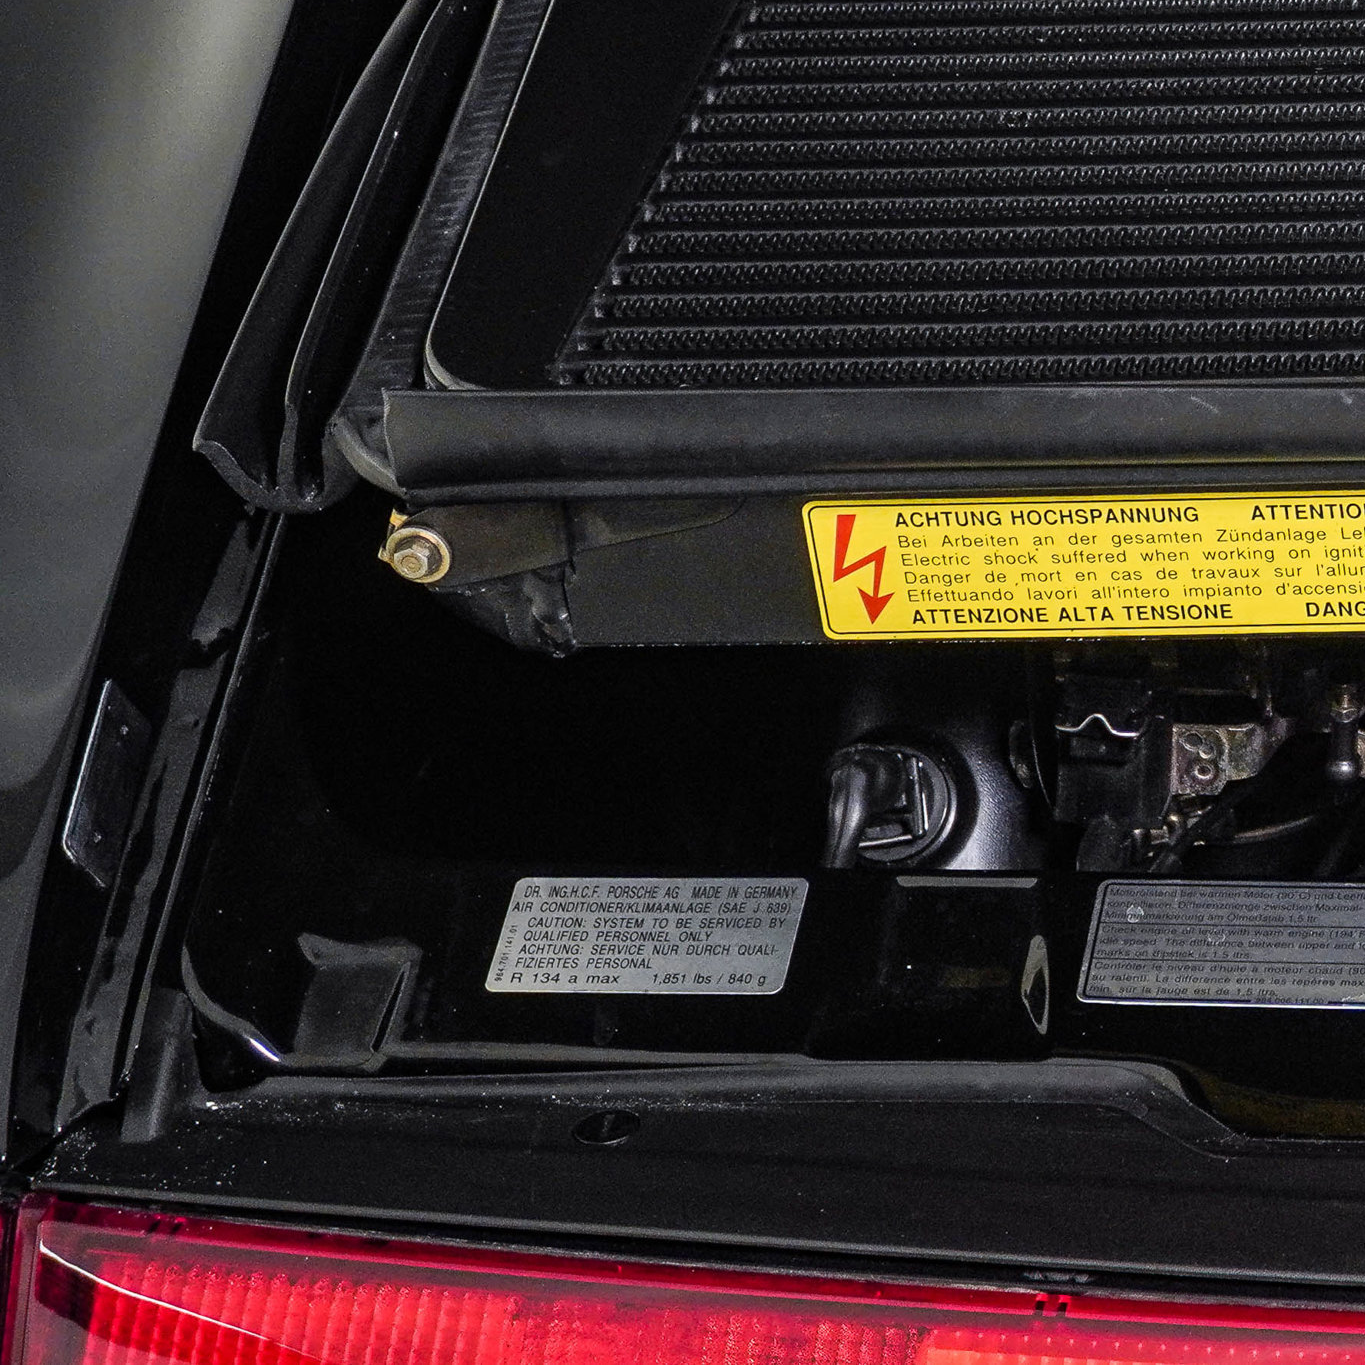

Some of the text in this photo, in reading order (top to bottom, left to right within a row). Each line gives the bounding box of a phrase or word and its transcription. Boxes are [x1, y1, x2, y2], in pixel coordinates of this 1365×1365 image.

[895, 506, 1199, 528] ACHTUNG HOCHSPANNUNG
[897, 535, 927, 549] Bei
[941, 534, 1019, 548] Arbeiten
[1032, 535, 1055, 547] an
[1068, 532, 1097, 546] der
[1111, 531, 1203, 548] gesamten
[1215, 527, 1327, 545] Zündanlage
[900, 553, 971, 567] Electric
[983, 550, 1037, 566] shock
[1051, 549, 1127, 565] suffered
[1140, 548, 1189, 562] when
[1202, 547, 1275, 563] working
[1288, 548, 1311, 560] on
[904, 571, 971, 588] Danger
[984, 570, 1007, 584] de
[1020, 570, 1062, 583] mort
[1075, 571, 1097, 582] en
[1110, 570, 1143, 581] cas
[1155, 566, 1178, 581] de
[1191, 567, 1260, 580] travaux
[1274, 567, 1302, 578] sur
[907, 587, 1014, 603] Effettuando
[1027, 587, 1078, 601] lavori
[1091, 586, 1170, 600] all'intero
[1183, 584, 1263, 600] impianto
[912, 603, 1233, 625] ATTENZIONE ALTA TENSIONE
[523, 884, 543, 899] DR.
[606, 886, 661, 899] PORSCHE
[663, 886, 681, 899] AG
[690, 886, 723, 899] MADE
[726, 886, 740, 899] IN
[743, 886, 798, 899] GERMANY
[527, 916, 787, 930] CAUTION: SYSTEM TO BE SERVICED BY
[523, 929, 714, 945] QUALIFIED PERSONNEL ONLY
[510, 971, 524, 984] R
[532, 972, 561, 984] 134
[567, 974, 578, 984] a
[653, 970, 687, 986] 1,851
[692, 972, 713, 985] lbs
[727, 972, 753, 985] 840
[757, 975, 767, 987] g
